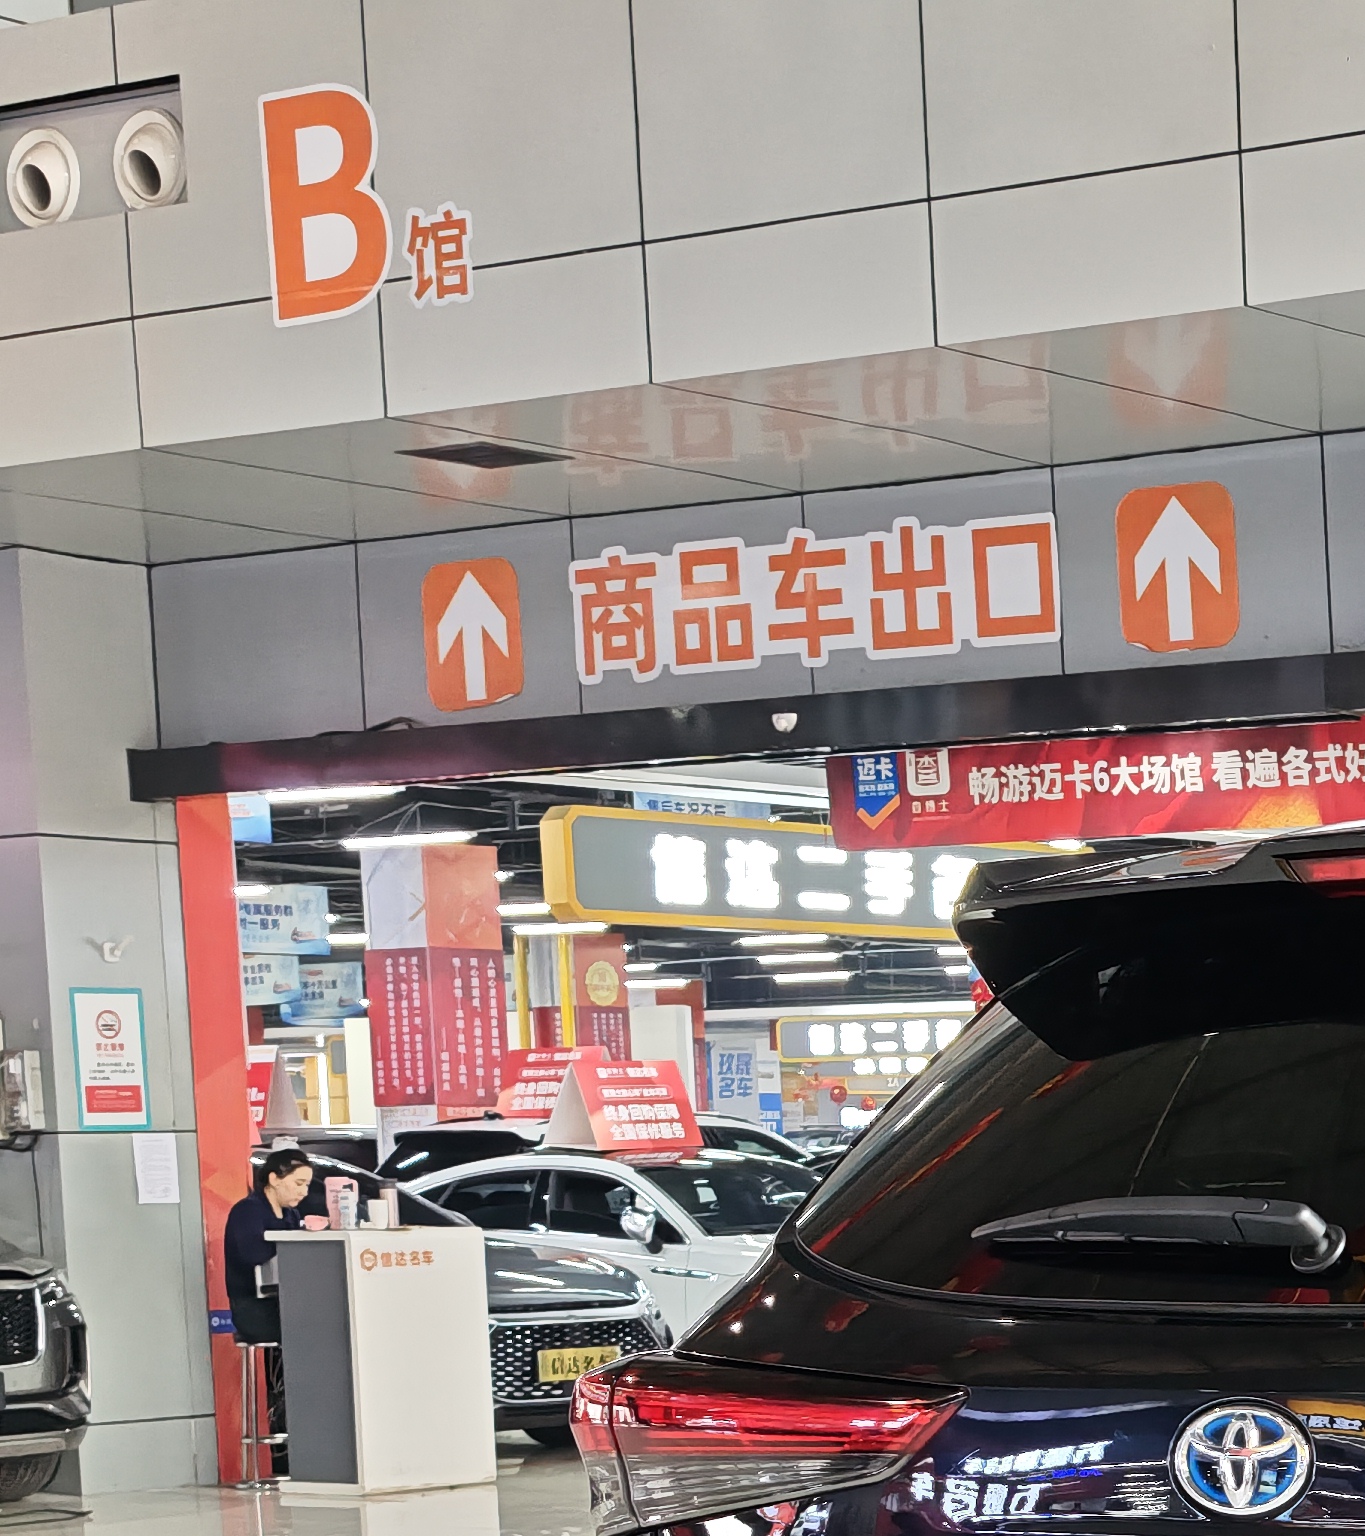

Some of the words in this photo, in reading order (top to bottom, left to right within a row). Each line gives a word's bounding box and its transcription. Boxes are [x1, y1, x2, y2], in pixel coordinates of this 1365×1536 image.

[574, 522, 1056, 679] 商品车出口
[857, 757, 893, 780] 迈卡
[968, 750, 1204, 806] 畅游迈卡6大场馆
[718, 1077, 753, 1099] 名车
